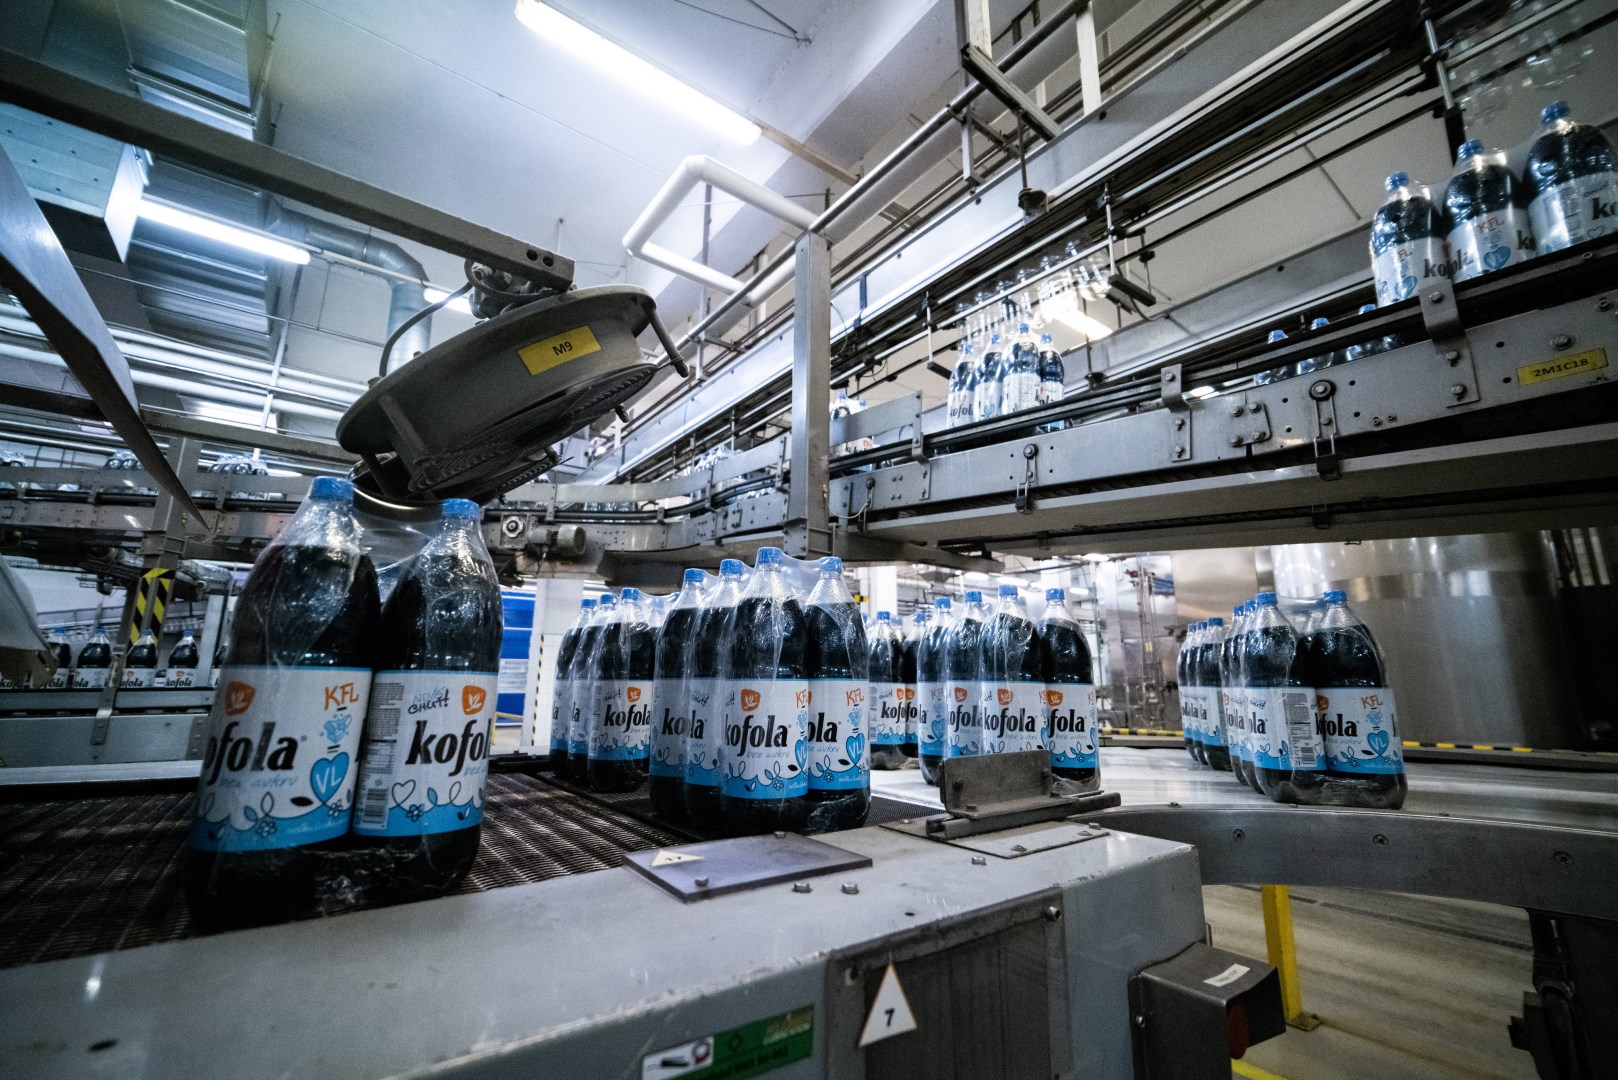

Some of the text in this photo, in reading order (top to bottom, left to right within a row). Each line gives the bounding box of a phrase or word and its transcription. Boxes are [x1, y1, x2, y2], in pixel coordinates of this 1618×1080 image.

[552, 341, 573, 356] M9
[1533, 358, 1589, 377] 2M1C18
[324, 682, 359, 711] KFL
[845, 687, 865, 707] KFL
[1361, 694, 1383, 709] KFL
[984, 707, 1036, 738] kofola
[1047, 708, 1085, 738] fola
[848, 740, 863, 759] VL
[1371, 736, 1387, 750] VL
[315, 766, 342, 795] VL
